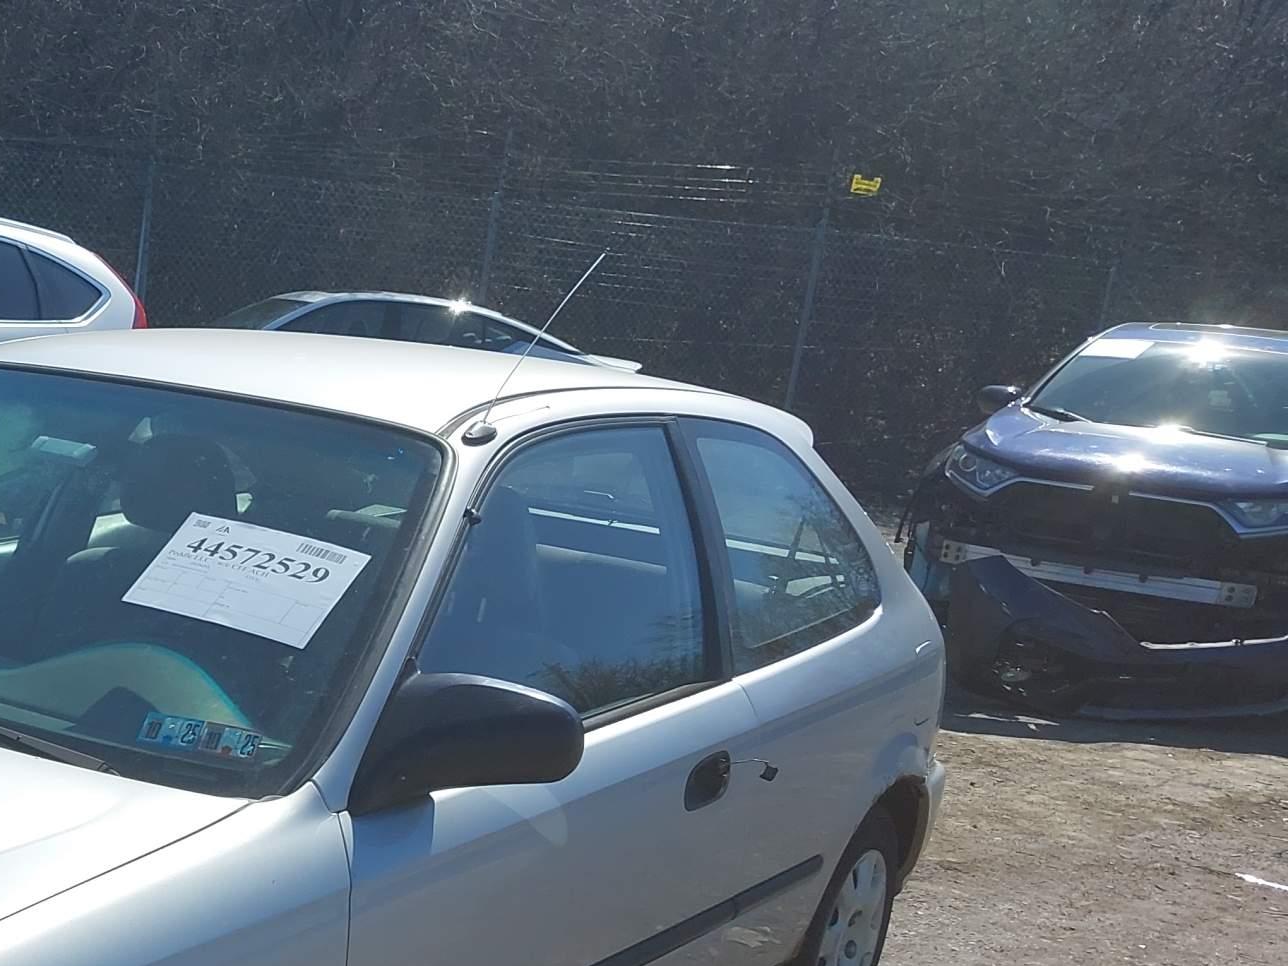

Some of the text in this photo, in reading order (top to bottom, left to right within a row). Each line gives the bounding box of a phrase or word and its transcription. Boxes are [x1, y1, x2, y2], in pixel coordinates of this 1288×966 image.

[186, 537, 331, 584] 44572529
[180, 723, 200, 745] 25
[239, 734, 259, 757] 25
